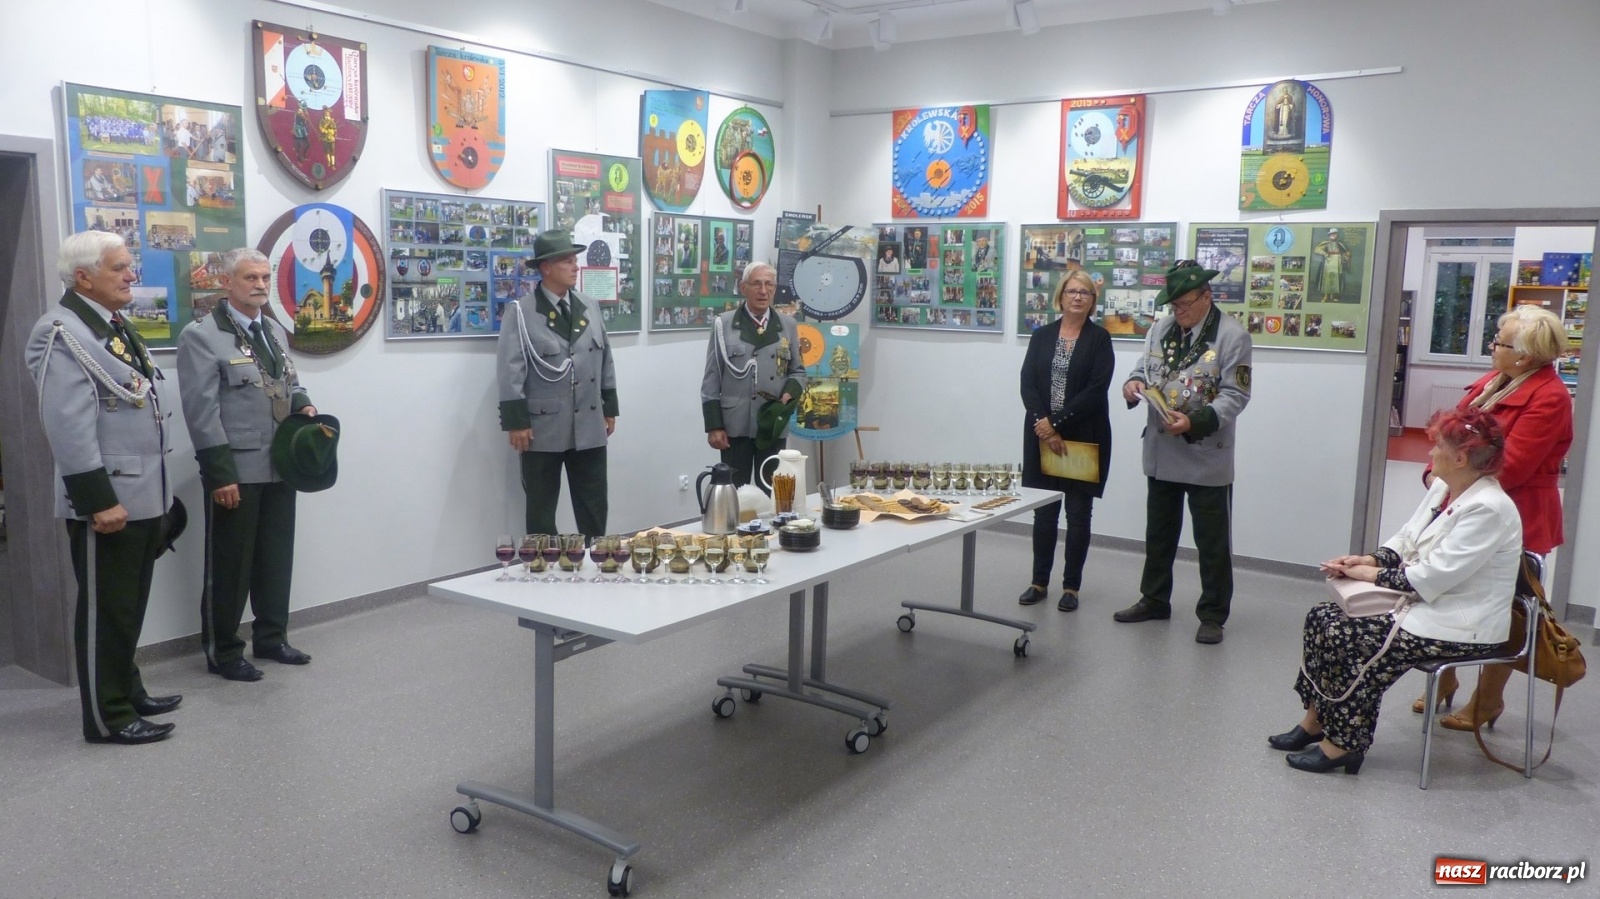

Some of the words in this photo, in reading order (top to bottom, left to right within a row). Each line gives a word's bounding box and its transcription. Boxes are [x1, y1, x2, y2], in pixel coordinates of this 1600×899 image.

[1070, 99, 1093, 108] 2015
[1244, 92, 1266, 126] TARCZA
[1306, 85, 1330, 134] HONOROWA
[965, 192, 985, 215] 2015
